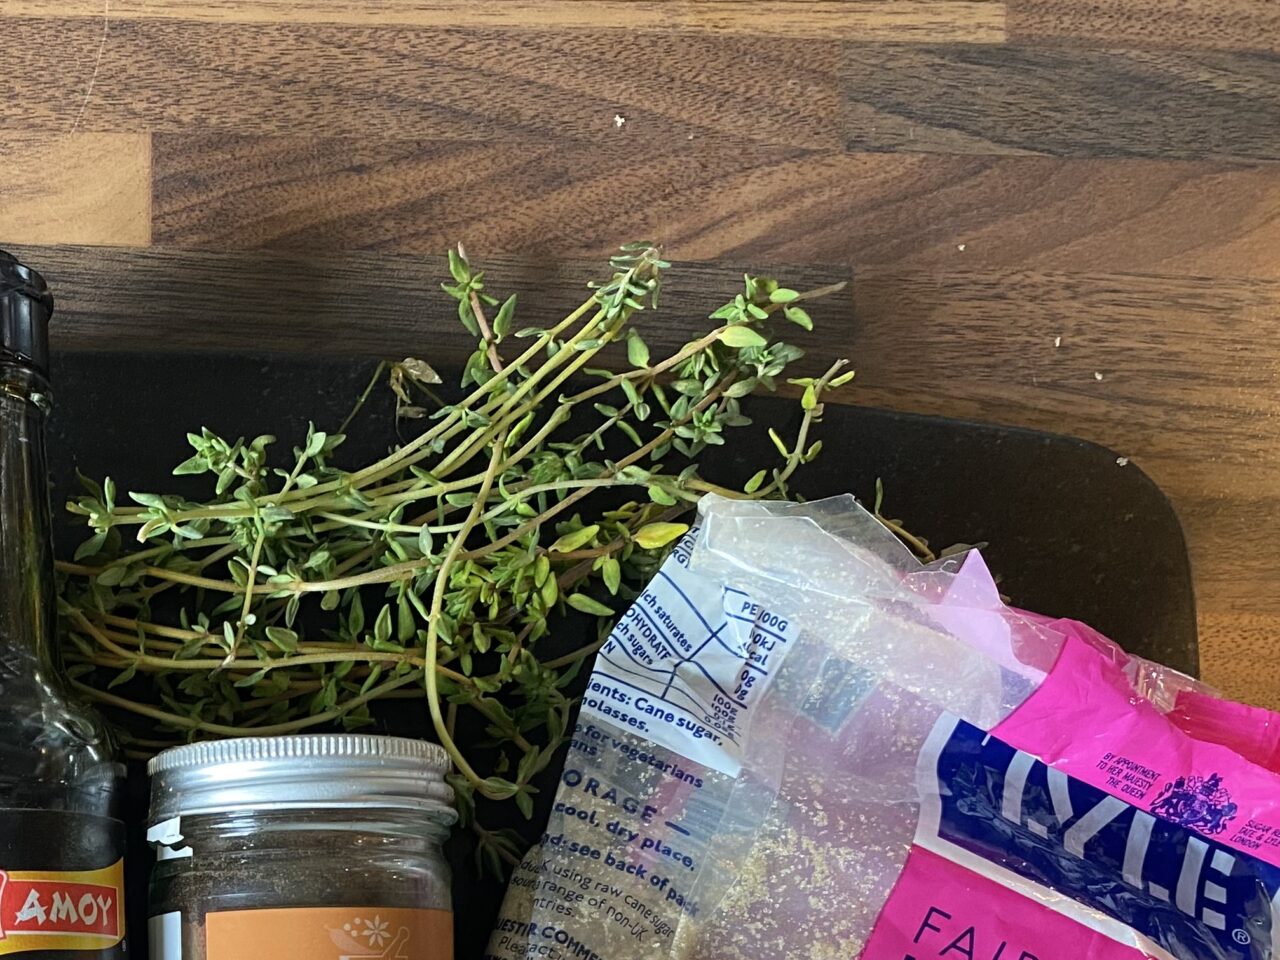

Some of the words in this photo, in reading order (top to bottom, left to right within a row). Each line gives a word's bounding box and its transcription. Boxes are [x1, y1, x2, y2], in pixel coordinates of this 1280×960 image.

[627, 636, 654, 665] sugars
[654, 605, 693, 653] saturates
[634, 697, 675, 723] Cane
[675, 716, 723, 747] sugar,
[584, 725, 610, 743] for
[612, 738, 704, 789] vegetarians
[563, 769, 658, 824] ORAGE
[554, 802, 600, 828] cool,
[606, 820, 639, 843] dry
[641, 837, 695, 872] place.
[569, 842, 601, 860] see
[604, 852, 648, 879] back
[649, 875, 669, 891] of
[14, 888, 112, 930] AMOY
[542, 881, 584, 902] range
[587, 897, 606, 910] of
[606, 906, 649, 942] non-UK
[552, 864, 592, 890] using
[594, 882, 624, 898] raw
[624, 894, 652, 920] cane
[651, 915, 675, 939] sugar
